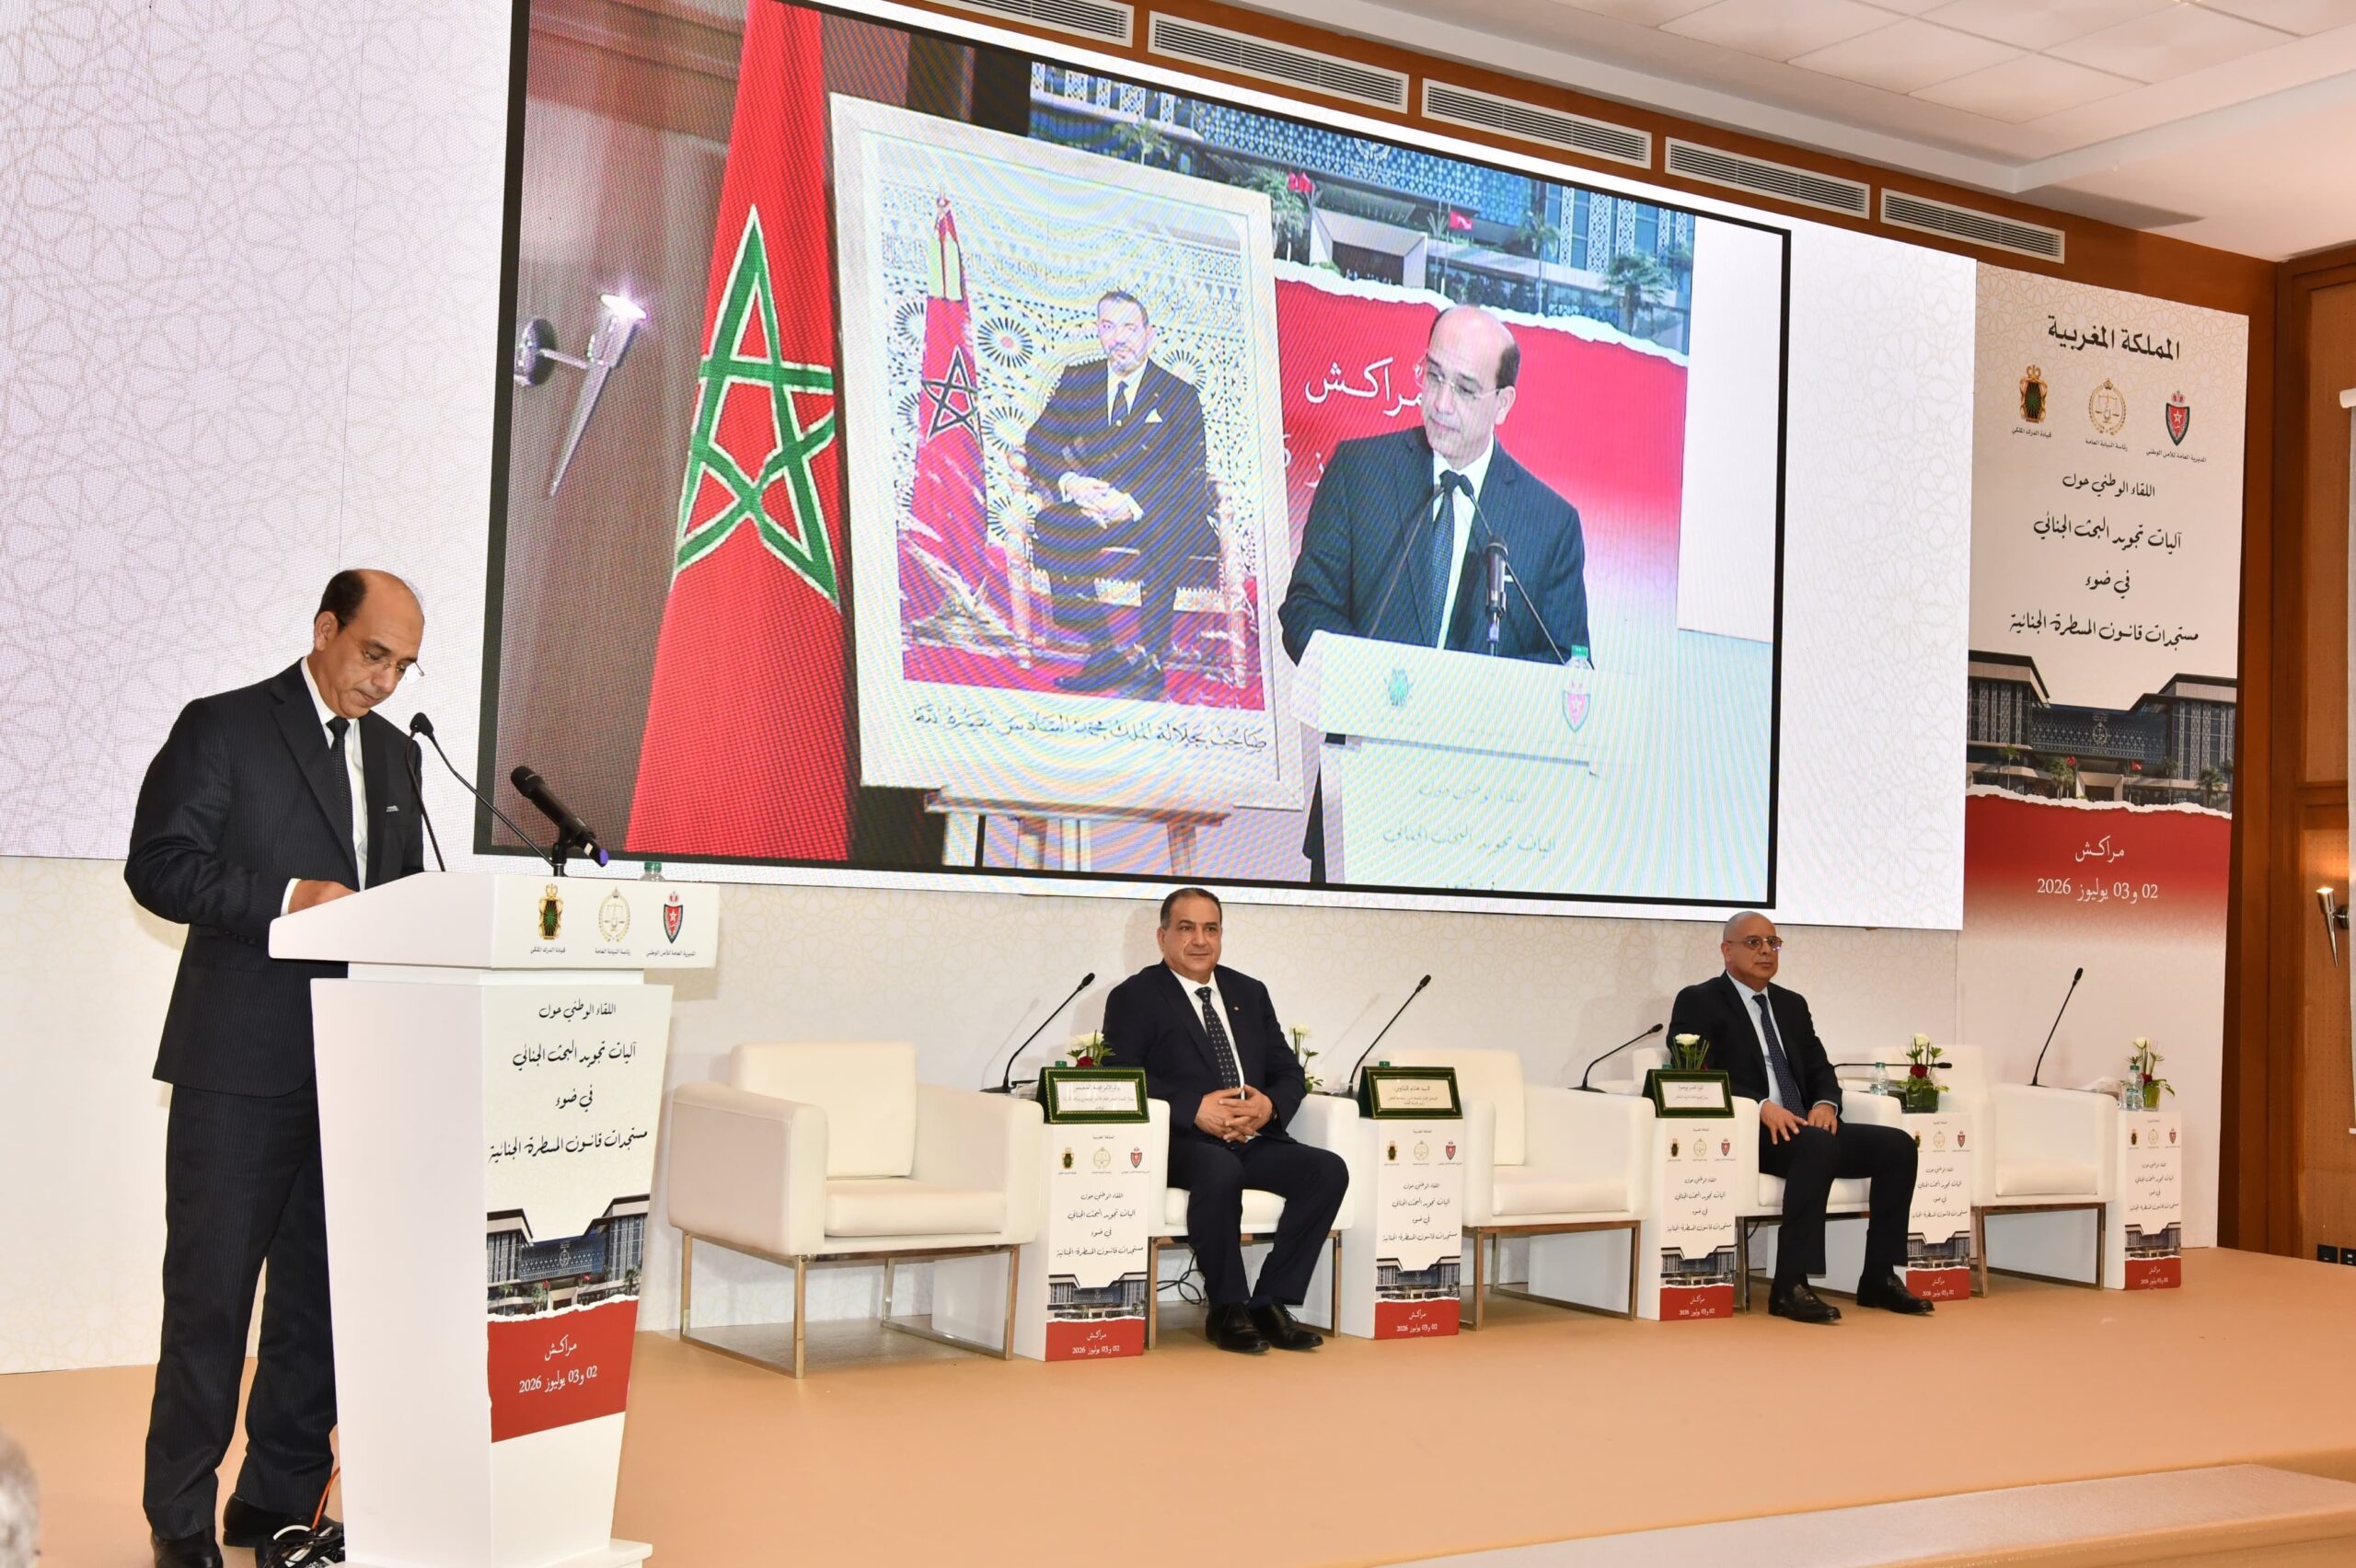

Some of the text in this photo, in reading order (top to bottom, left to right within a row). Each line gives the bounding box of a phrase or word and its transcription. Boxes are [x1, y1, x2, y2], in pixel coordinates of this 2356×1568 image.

[2048, 315, 2180, 361] المملكة المغربية
[2062, 472, 2155, 498] اللقاء الوطني حول
[2033, 511, 2182, 555] آليات تجويد البحث الجنائي
[2085, 569, 2131, 599] في ضوء
[2009, 609, 2199, 651] مستجدات قانون المسطرة الجنائية
[2075, 835, 2125, 862] مراكش
[2037, 878, 2071, 894] 2026
[2076, 877, 2108, 903] يوليوز
[2142, 883, 2158, 899] 02
[538, 997, 616, 1022] اللقاء الوطني حول
[513, 1039, 636, 1071] آليات تجويد البحث الجنائي
[555, 1084, 593, 1112] في ضوء
[488, 1127, 648, 1164] مستجدات قانون المسطرة الجنائية
[545, 1334, 577, 1361] مراكش
[1087, 1329, 1106, 1341] مراكش
[1072, 1345, 1086, 1355] 2026
[519, 1376, 542, 1393] 2026
[545, 1370, 565, 1392] يوليوز
[586, 1366, 597, 1378] 02
